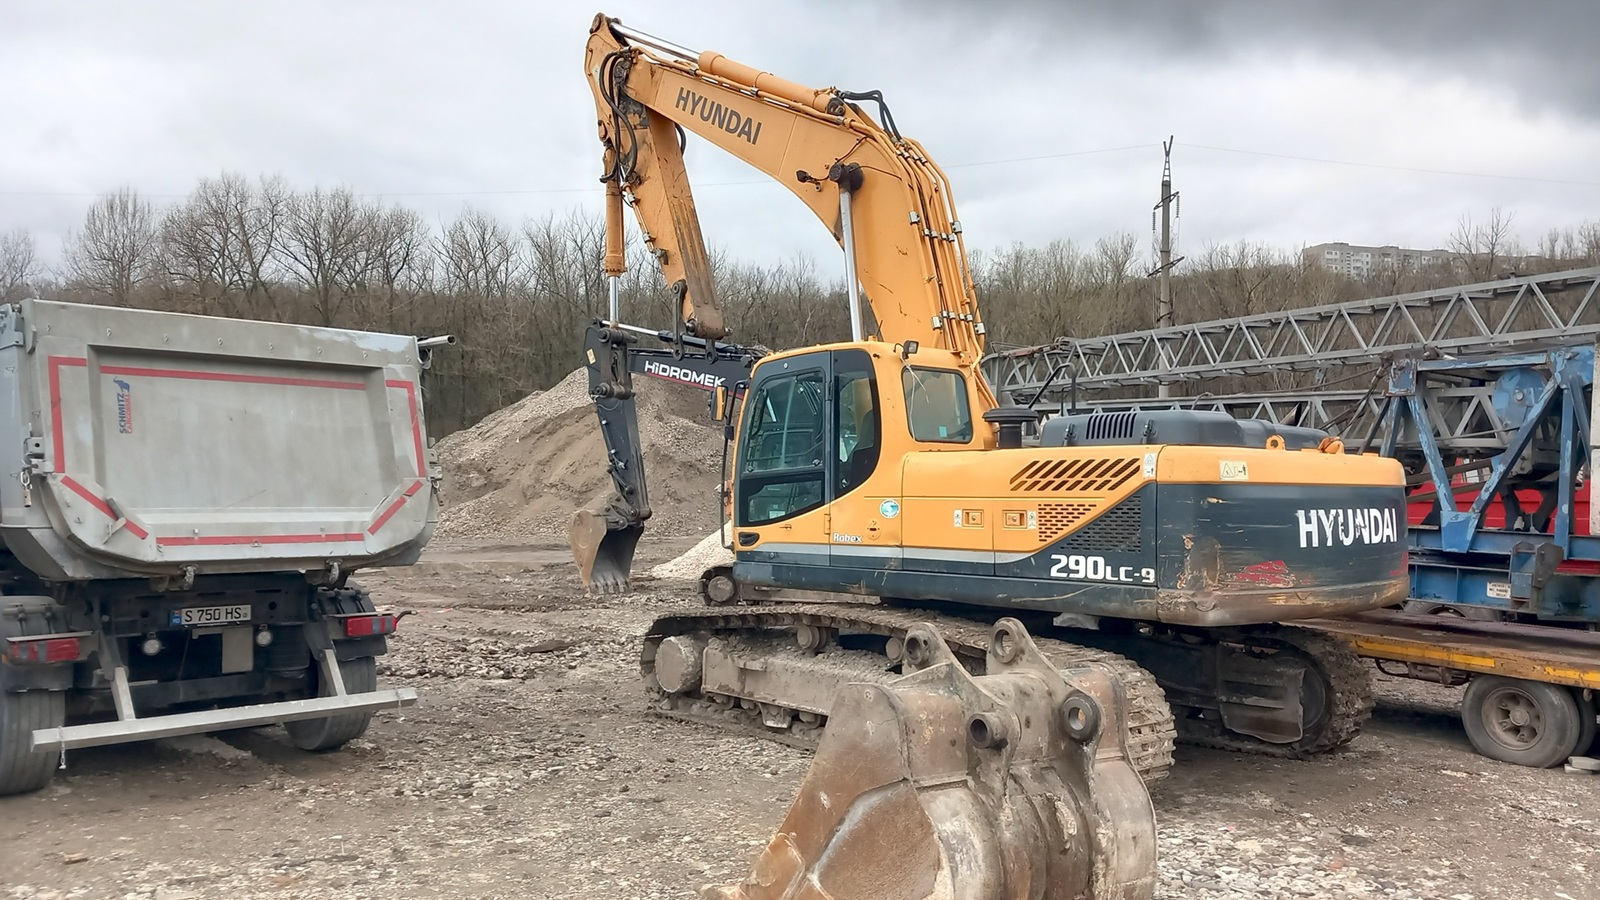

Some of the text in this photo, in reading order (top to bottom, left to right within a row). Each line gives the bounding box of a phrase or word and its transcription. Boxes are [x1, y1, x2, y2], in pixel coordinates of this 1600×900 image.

[675, 86, 762, 145] HYUNDAI
[117, 392, 127, 434] SCHMITZ
[833, 532, 863, 543] Robex
[1296, 508, 1397, 548] HYUNDAI
[184, 607, 242, 622] S 750 HS
